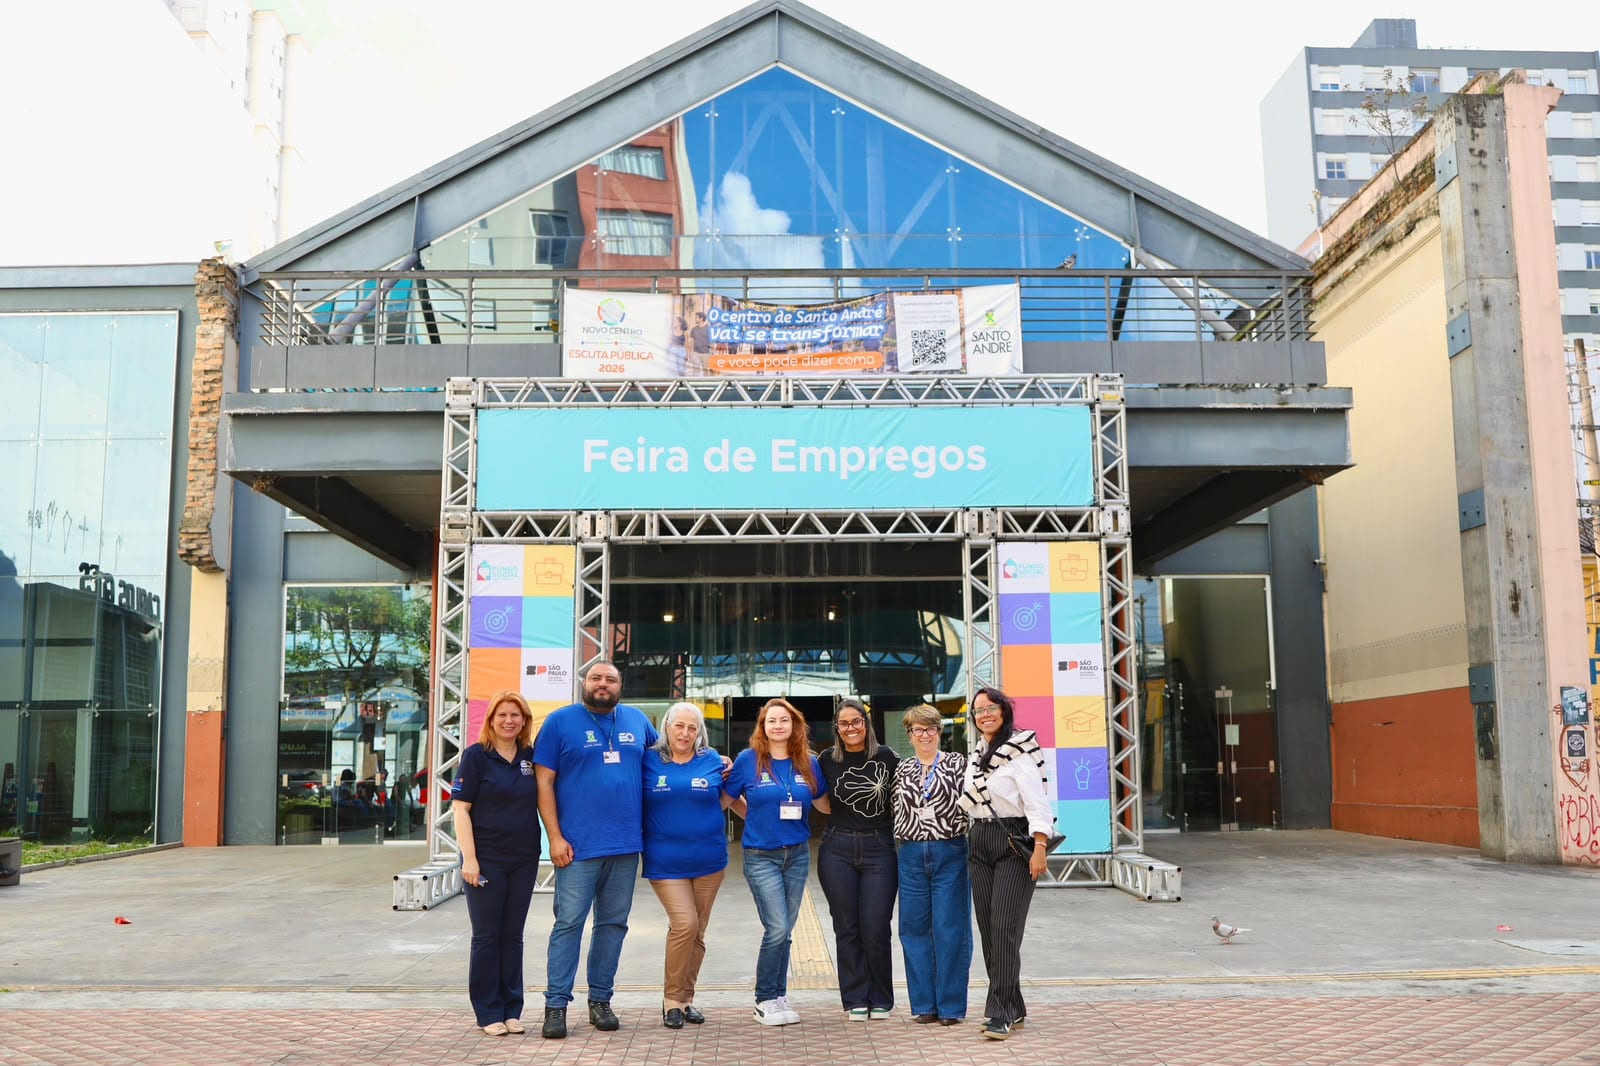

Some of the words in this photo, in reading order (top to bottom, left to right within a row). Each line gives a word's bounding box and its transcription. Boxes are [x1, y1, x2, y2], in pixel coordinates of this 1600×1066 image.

[709, 311, 719, 321] O
[721, 309, 770, 323] centro
[774, 309, 791, 323] de
[795, 310, 837, 323] Santo
[840, 304, 883, 321] André
[583, 326, 608, 334] NOVO
[609, 327, 643, 336] CENTRO
[745, 330, 766, 341] se
[772, 325, 884, 342] transformar
[971, 331, 1011, 342] SANTO
[569, 349, 608, 359] ESCUTA
[610, 348, 654, 360] PÚBLICA
[598, 364, 625, 372] 2026
[717, 359, 724, 367] e
[764, 357, 798, 370] pode
[801, 356, 834, 366] dizer
[837, 355, 875, 365] como
[583, 437, 688, 472] Feira
[703, 440, 756, 472] de
[771, 439, 986, 479] Empregos
